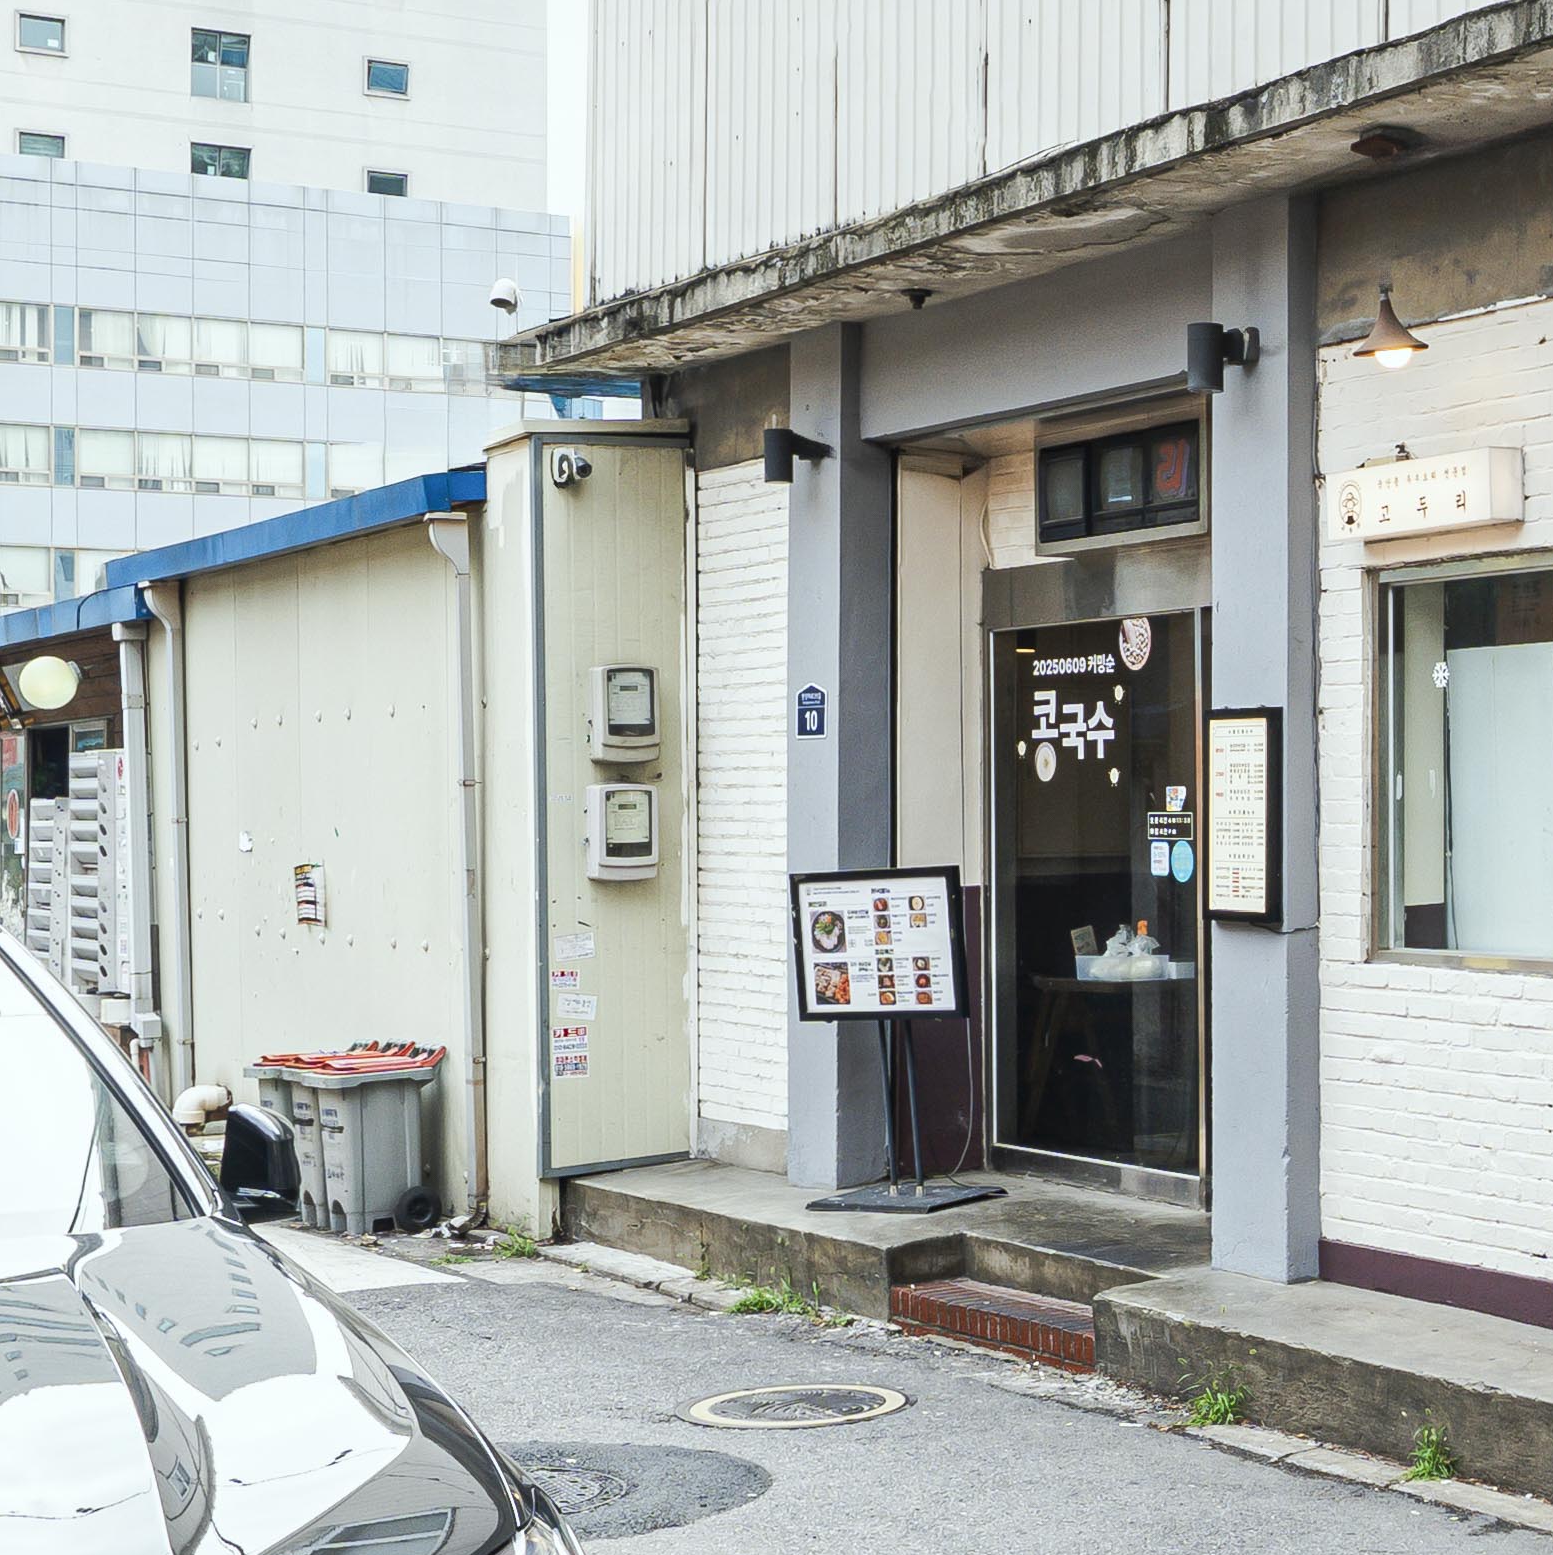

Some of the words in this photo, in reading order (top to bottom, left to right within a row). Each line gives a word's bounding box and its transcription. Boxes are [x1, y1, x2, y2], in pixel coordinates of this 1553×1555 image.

[1378, 489, 1467, 524] 고두리
[1032, 656, 1087, 677] 20250609
[1087, 652, 1116, 676] 커밍순
[804, 709, 818, 732] 10
[1031, 689, 1116, 782] 콩국수
